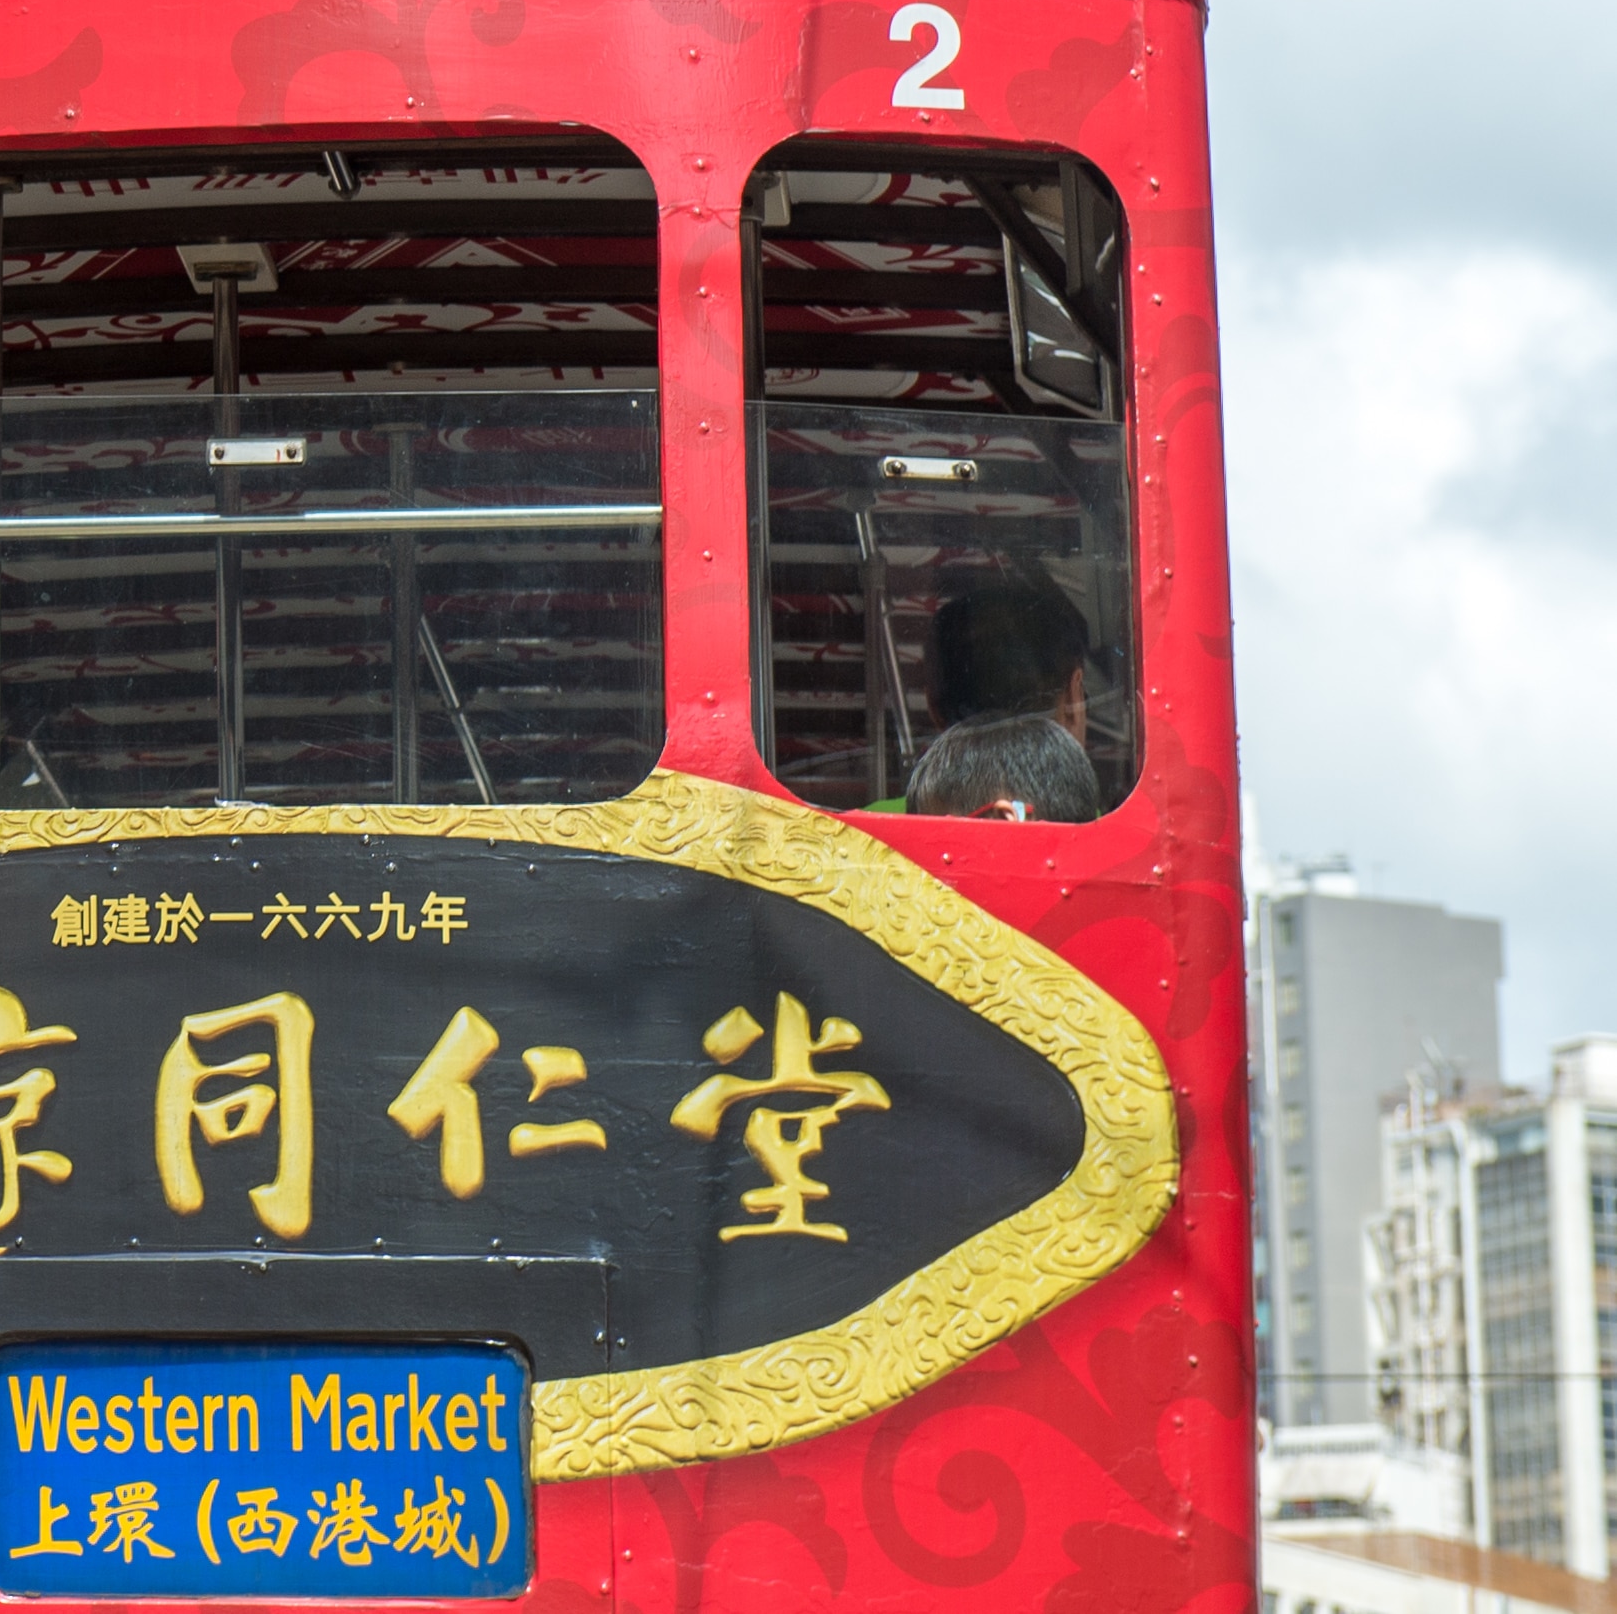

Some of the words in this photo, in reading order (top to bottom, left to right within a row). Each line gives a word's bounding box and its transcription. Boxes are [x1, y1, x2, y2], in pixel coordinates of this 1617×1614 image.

[889, 3, 966, 110] 2
[50, 891, 469, 948] 創建於一六六九年
[7, 1374, 260, 1453] Western
[289, 1372, 508, 1453] Market
